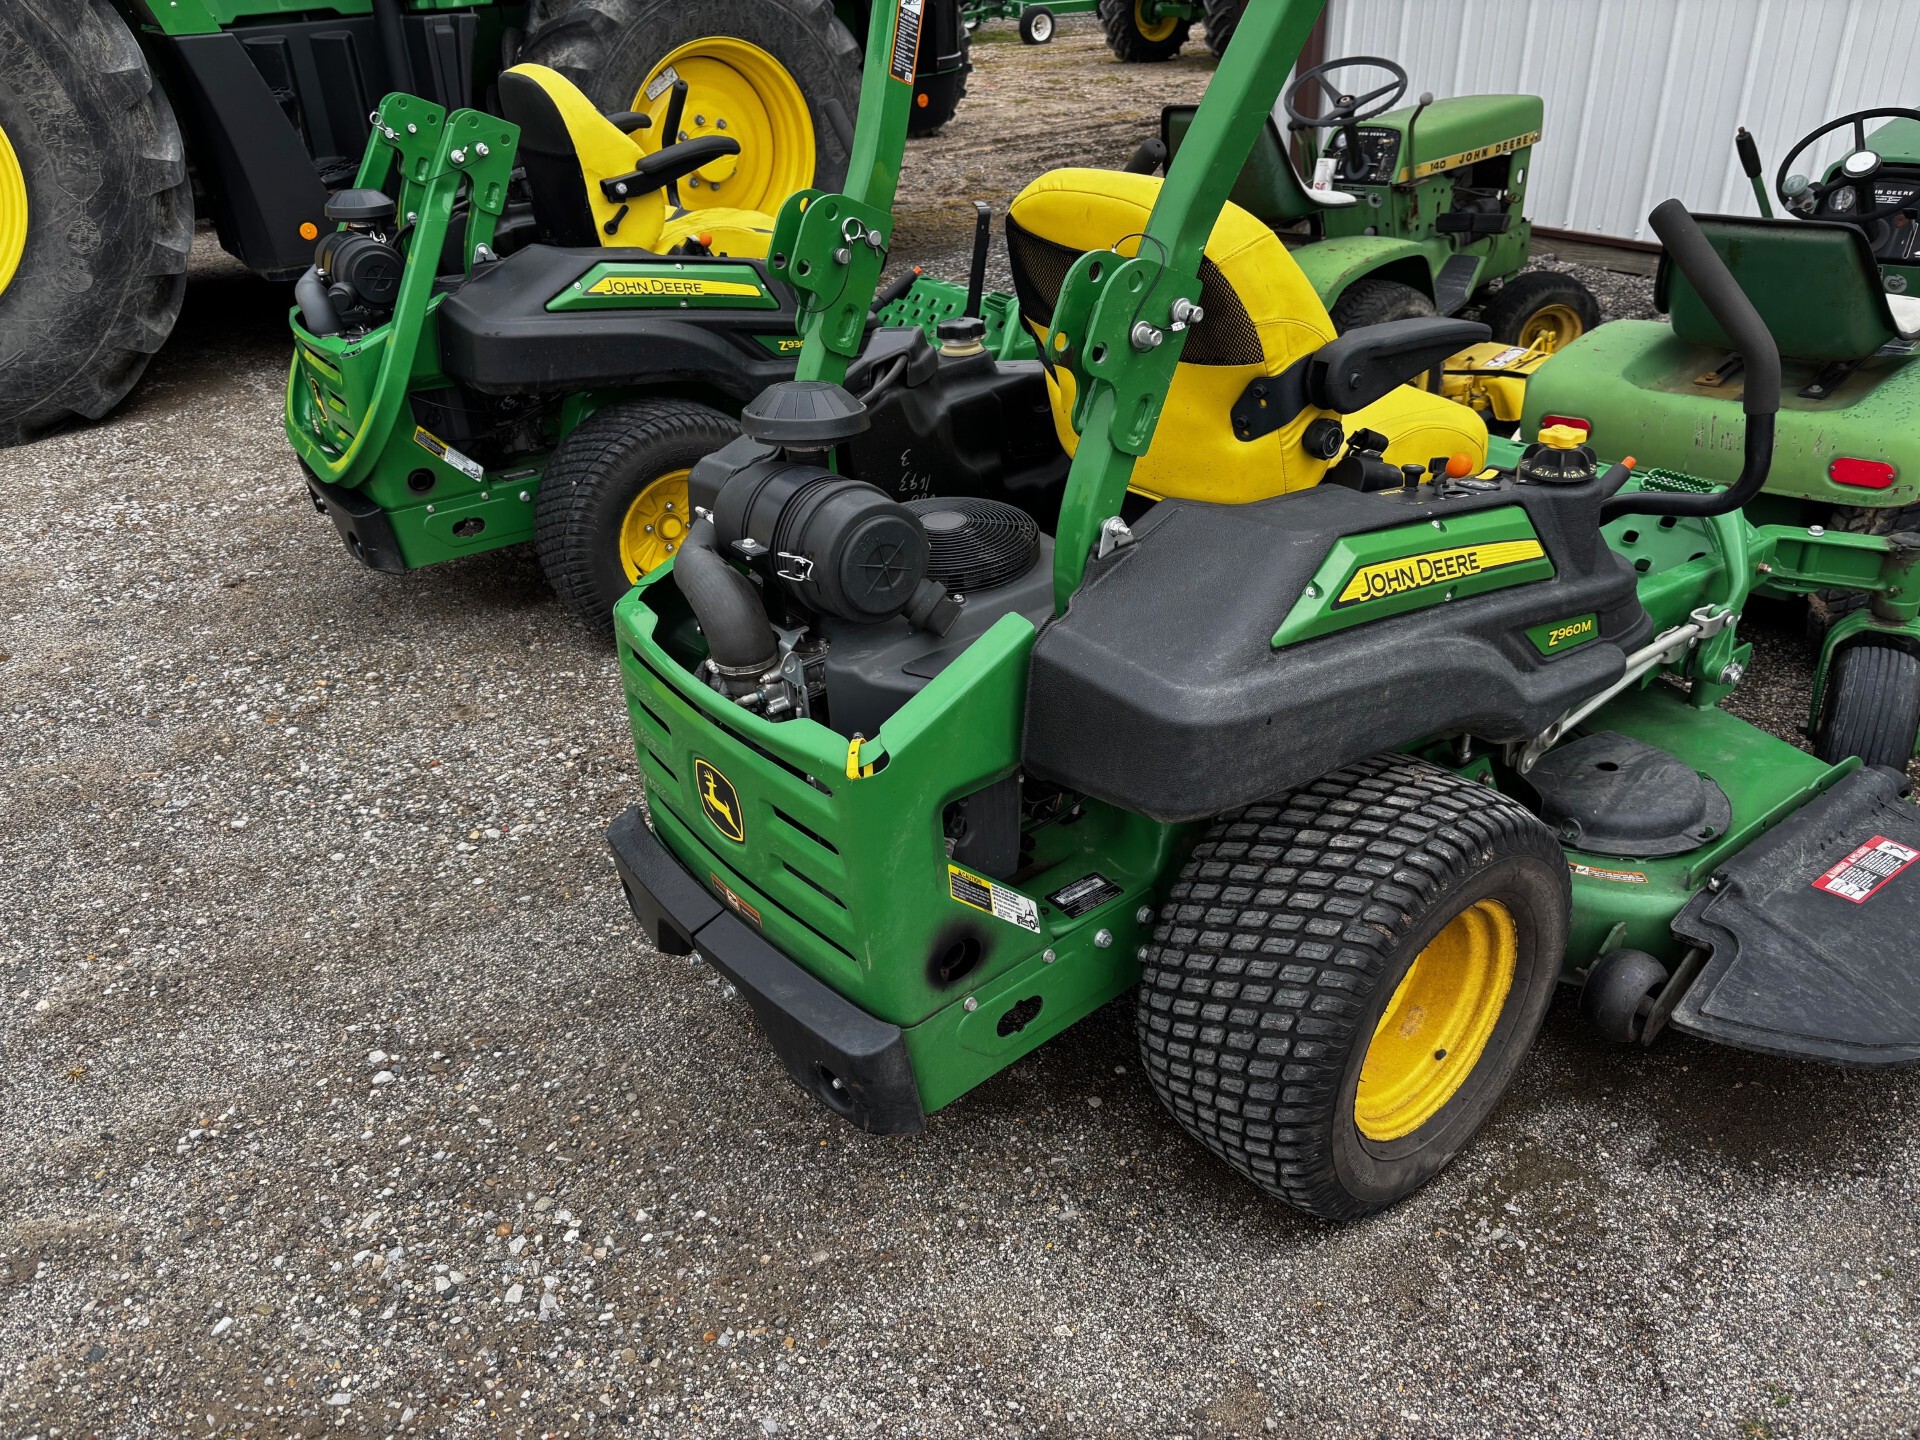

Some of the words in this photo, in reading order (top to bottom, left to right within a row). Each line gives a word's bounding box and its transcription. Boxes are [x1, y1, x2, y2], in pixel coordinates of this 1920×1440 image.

[1430, 159, 1446, 171] 140
[1459, 147, 1488, 165] JOHN
[1495, 135, 1529, 154] DEERE
[605, 279, 648, 294] JOHN
[650, 279, 704, 293] DEERE
[1360, 565, 1415, 598] JOHN
[1416, 551, 1480, 582] DEERE
[1548, 619, 1592, 647] Z960M
